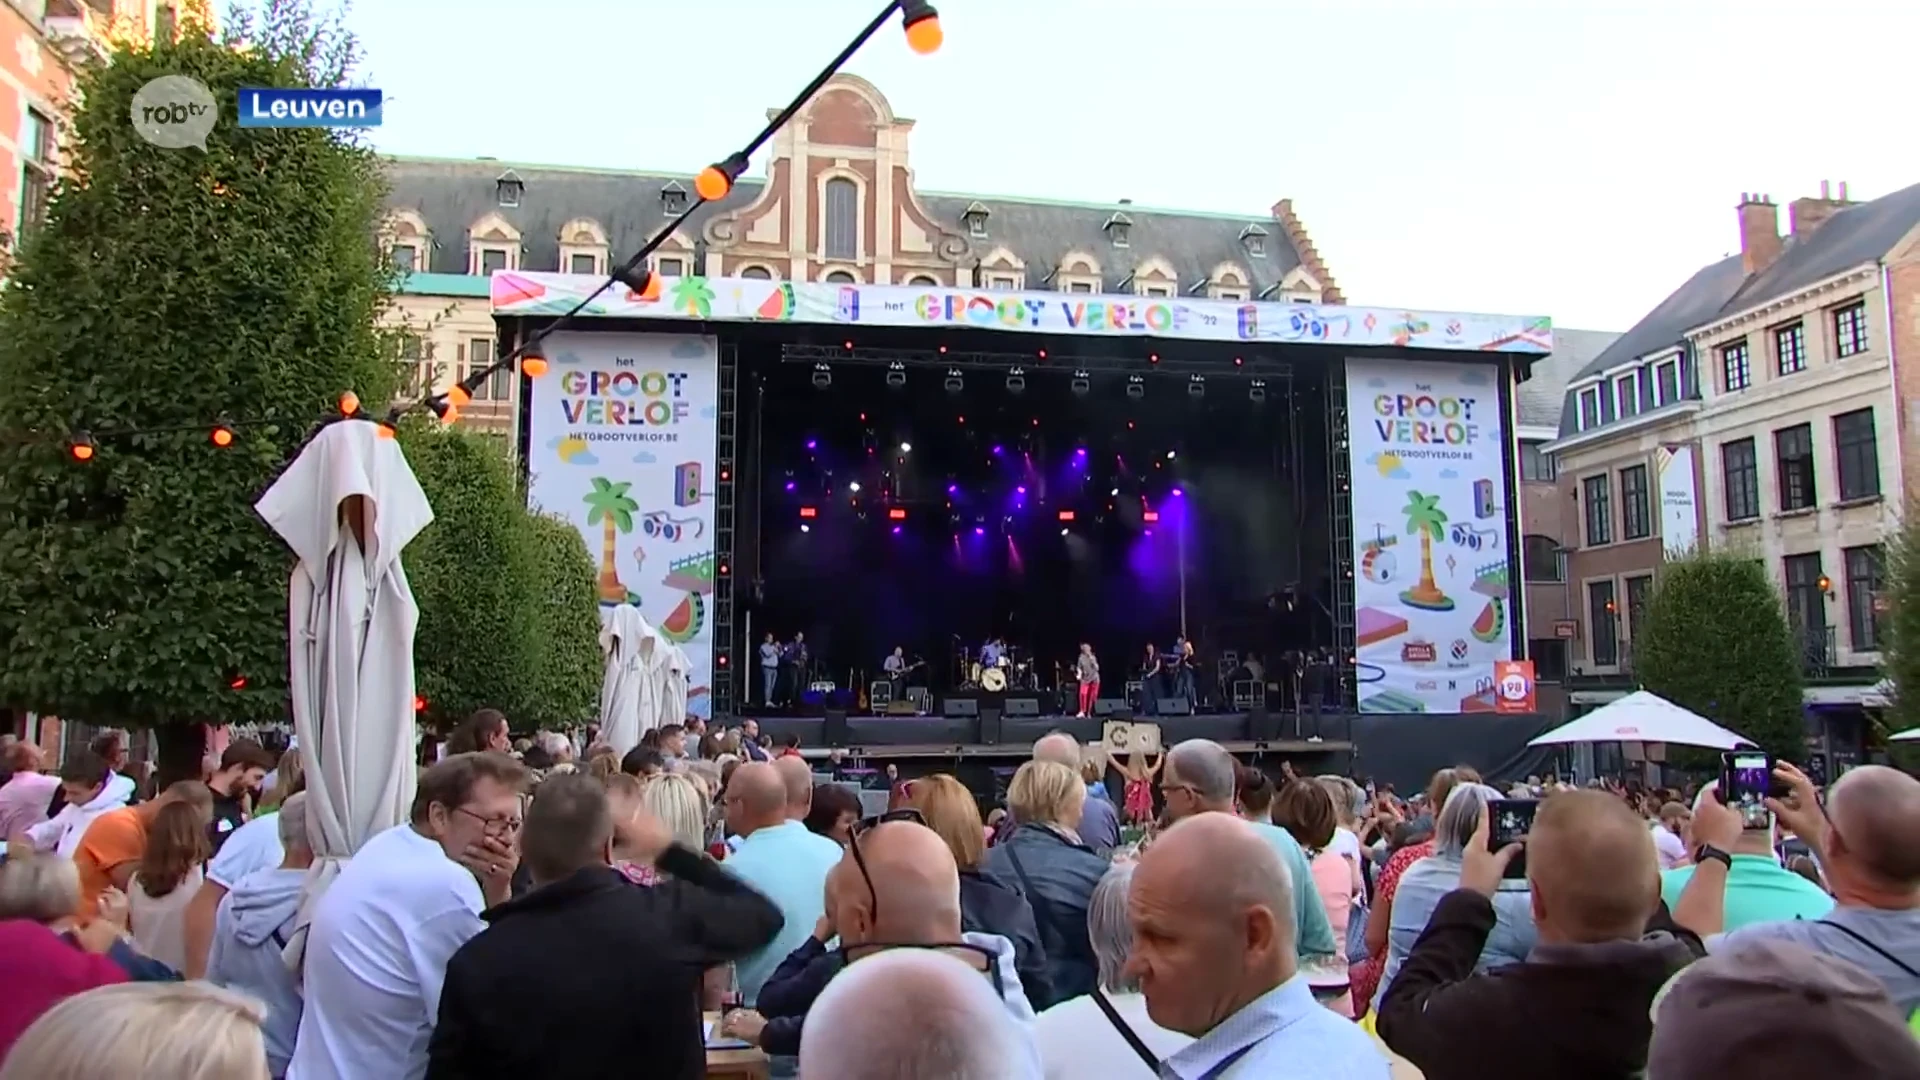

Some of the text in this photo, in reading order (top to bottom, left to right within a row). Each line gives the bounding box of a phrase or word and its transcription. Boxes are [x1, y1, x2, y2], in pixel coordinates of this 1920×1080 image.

[884, 302, 904, 312] het
[915, 294, 1046, 326] GROOT
[1062, 302, 1189, 330] VERLOF
[616, 356, 635, 367] het
[562, 371, 688, 397] GROOT
[1415, 383, 1432, 392] het
[561, 399, 690, 425] VERLOF
[1374, 394, 1476, 420] GROOT
[569, 432, 678, 442] HETGROOTVERLOF.BE
[1374, 419, 1479, 445] VERLOF
[1384, 450, 1473, 460] HETGROOTVERLOF.BE
[1507, 682, 1523, 693] 98
